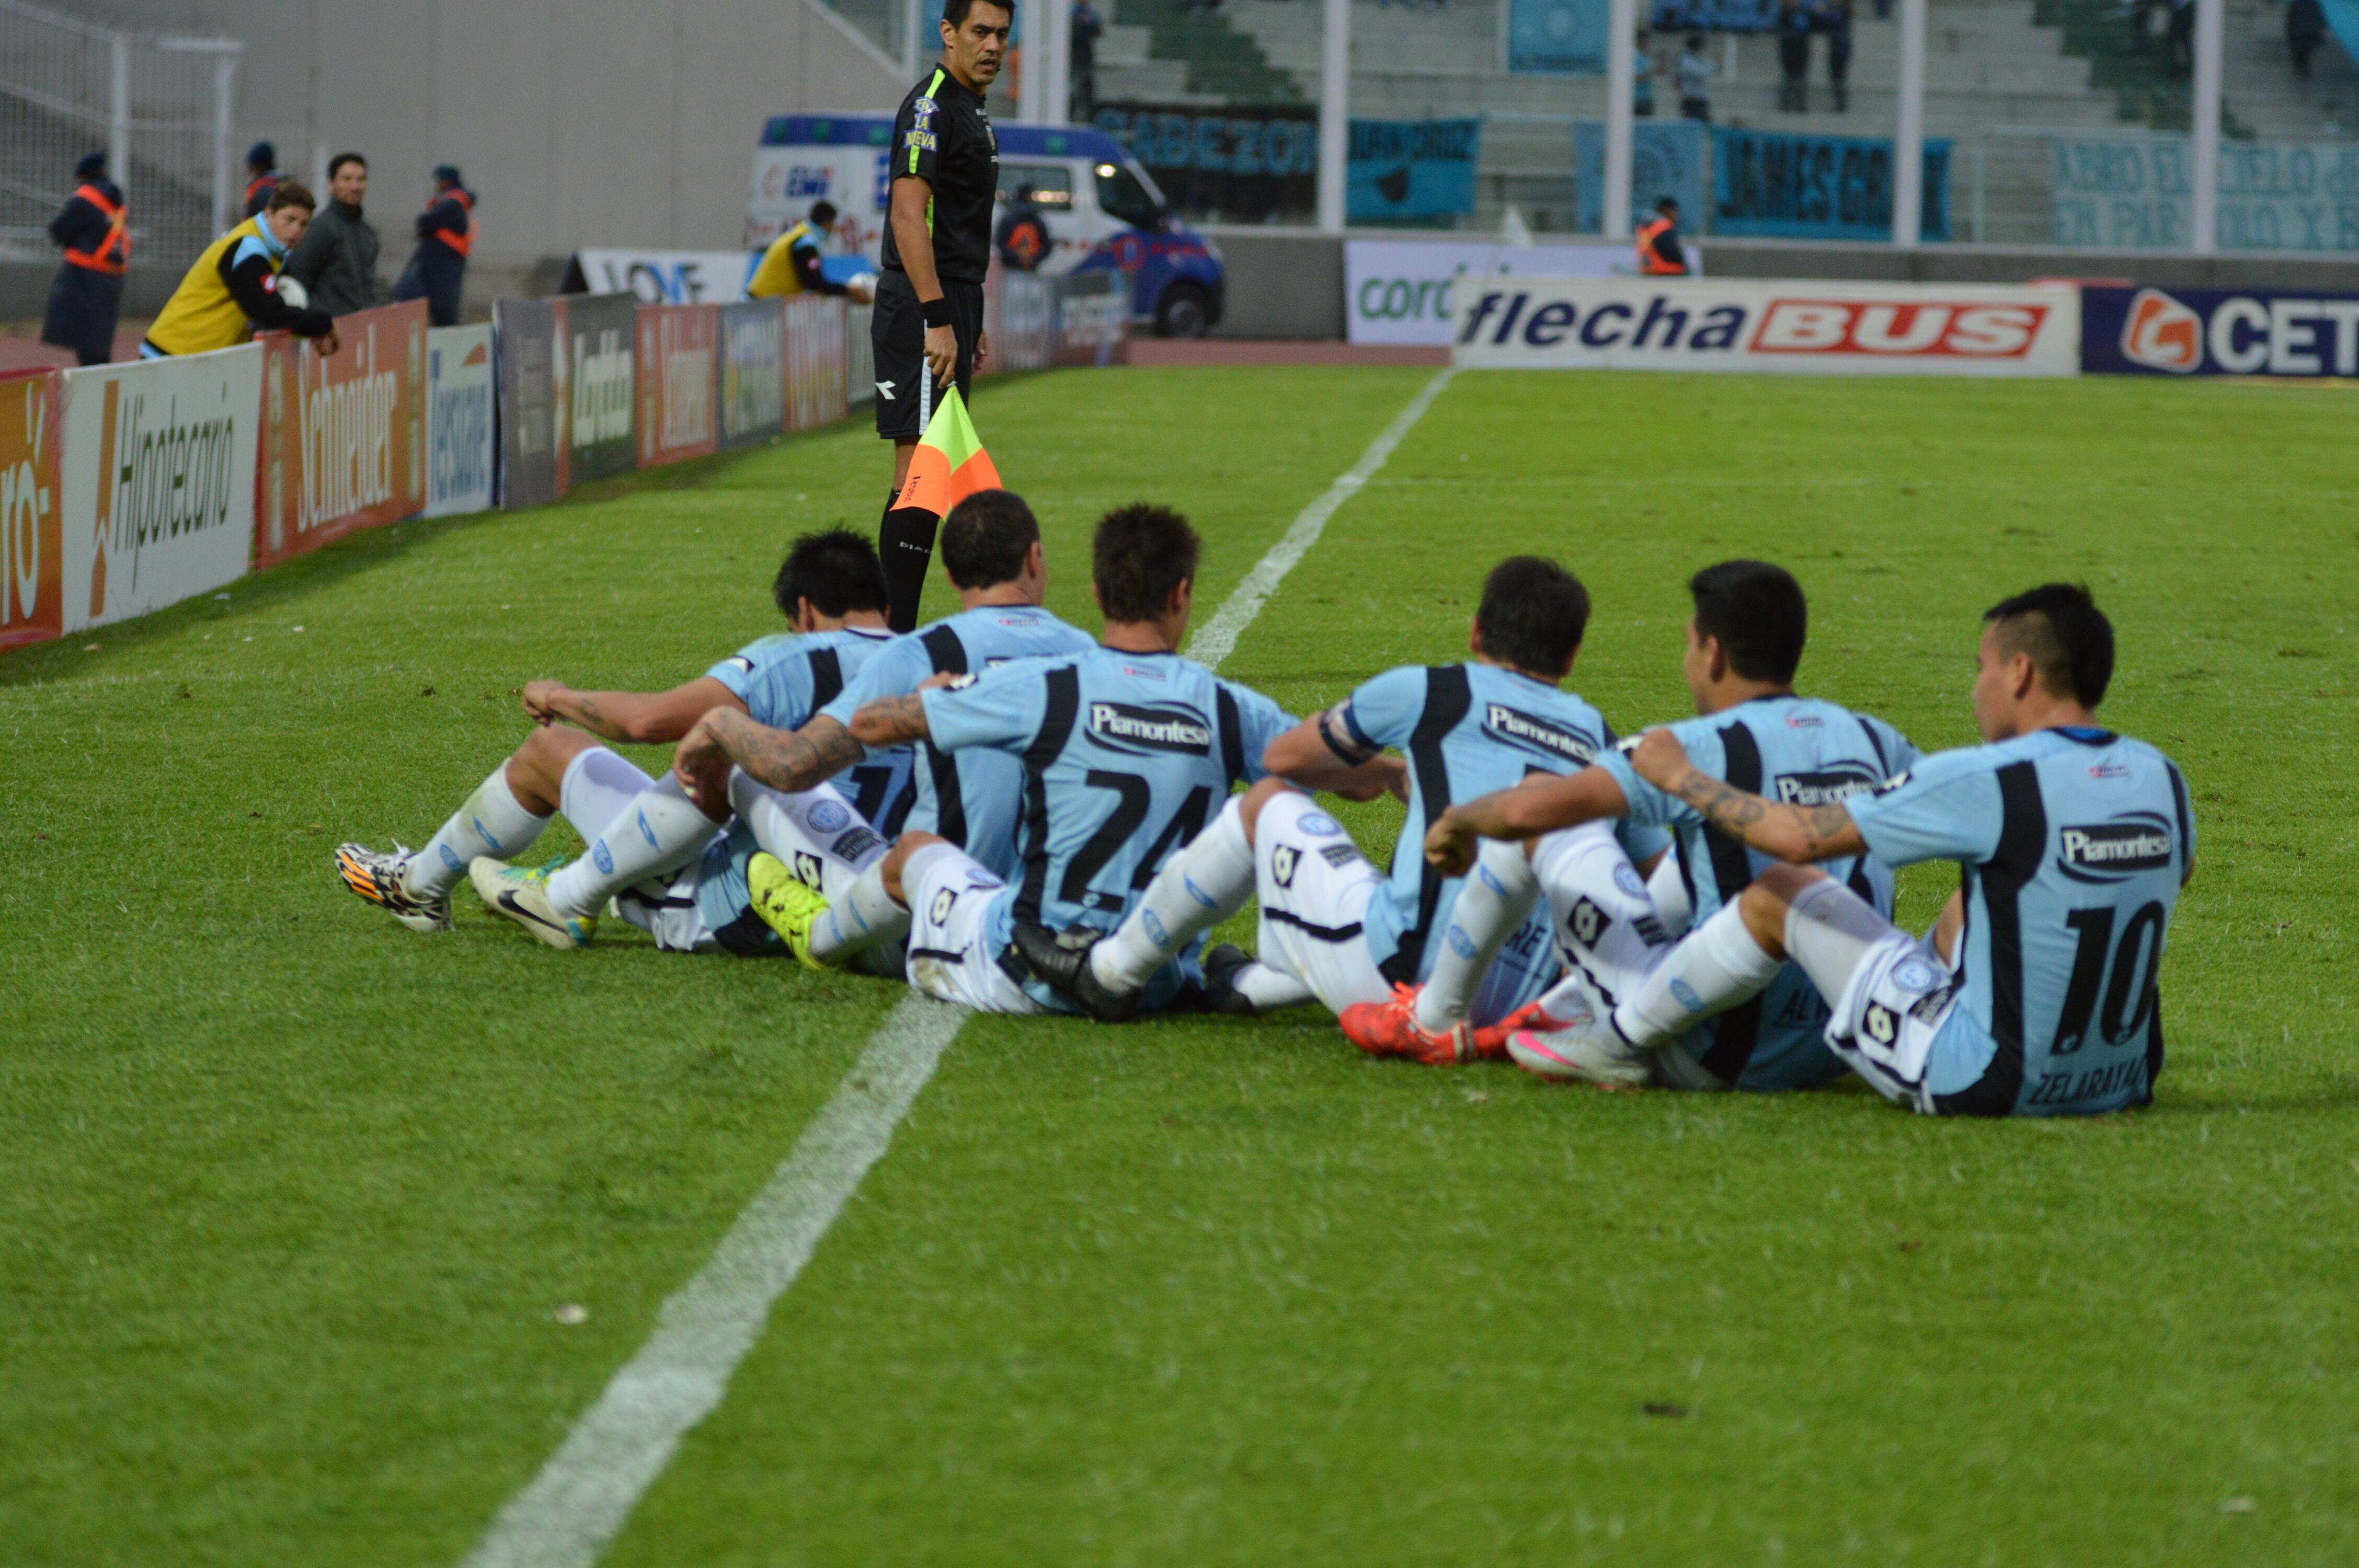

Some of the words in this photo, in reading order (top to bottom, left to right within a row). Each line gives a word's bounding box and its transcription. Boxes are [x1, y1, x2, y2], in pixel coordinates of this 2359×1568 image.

[114, 381, 234, 594] Hipotecario
[297, 323, 399, 533] Schneider
[1092, 704, 1210, 746] Piamontesa
[2063, 829, 2171, 863] Piamontesa
[2049, 899, 2165, 1057] 10
